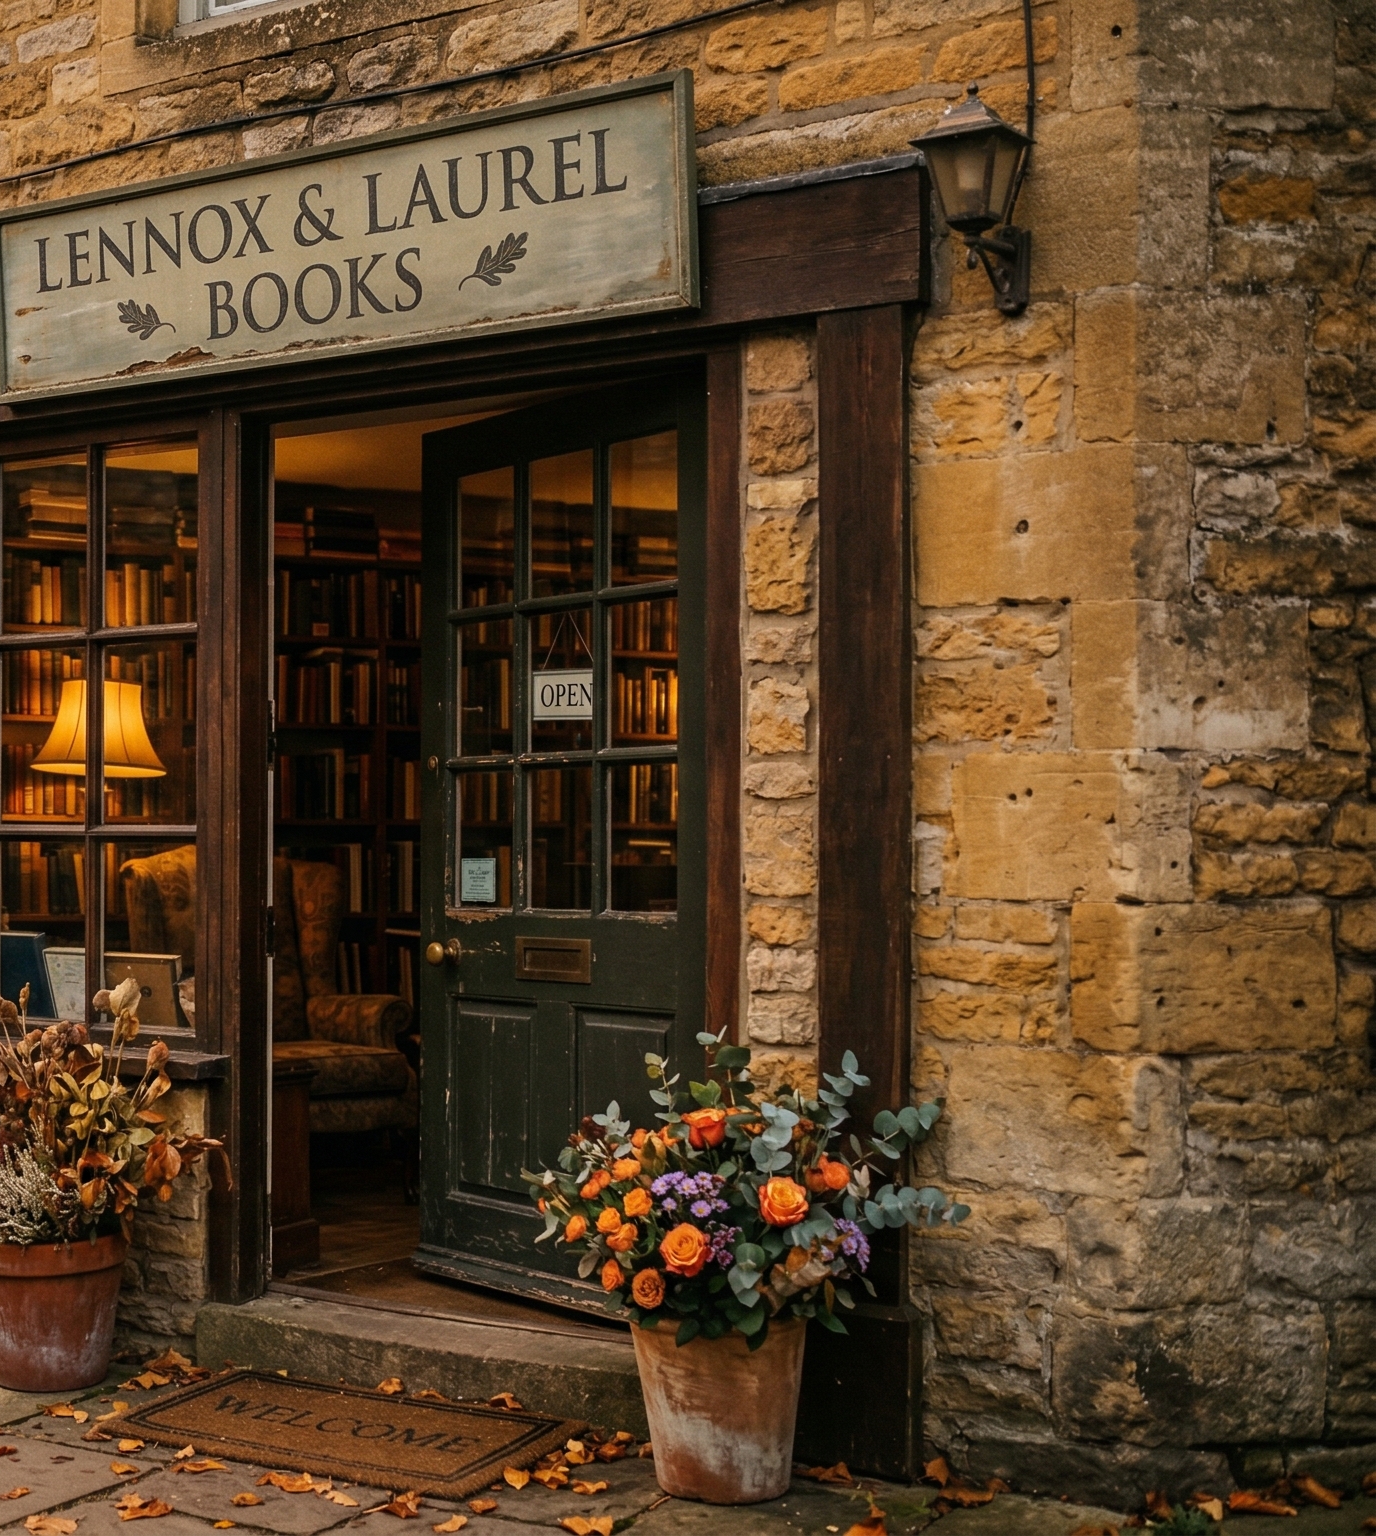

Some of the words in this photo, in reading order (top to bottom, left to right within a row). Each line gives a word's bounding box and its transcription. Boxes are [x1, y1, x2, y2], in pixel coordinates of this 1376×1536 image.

[34, 193, 275, 294] LENNOX
[293, 183, 344, 248] &
[362, 127, 628, 237] LAUREL
[204, 246, 424, 341] BOOKS
[540, 683, 593, 707] OPEN
[213, 1394, 481, 1455] WELCOME
